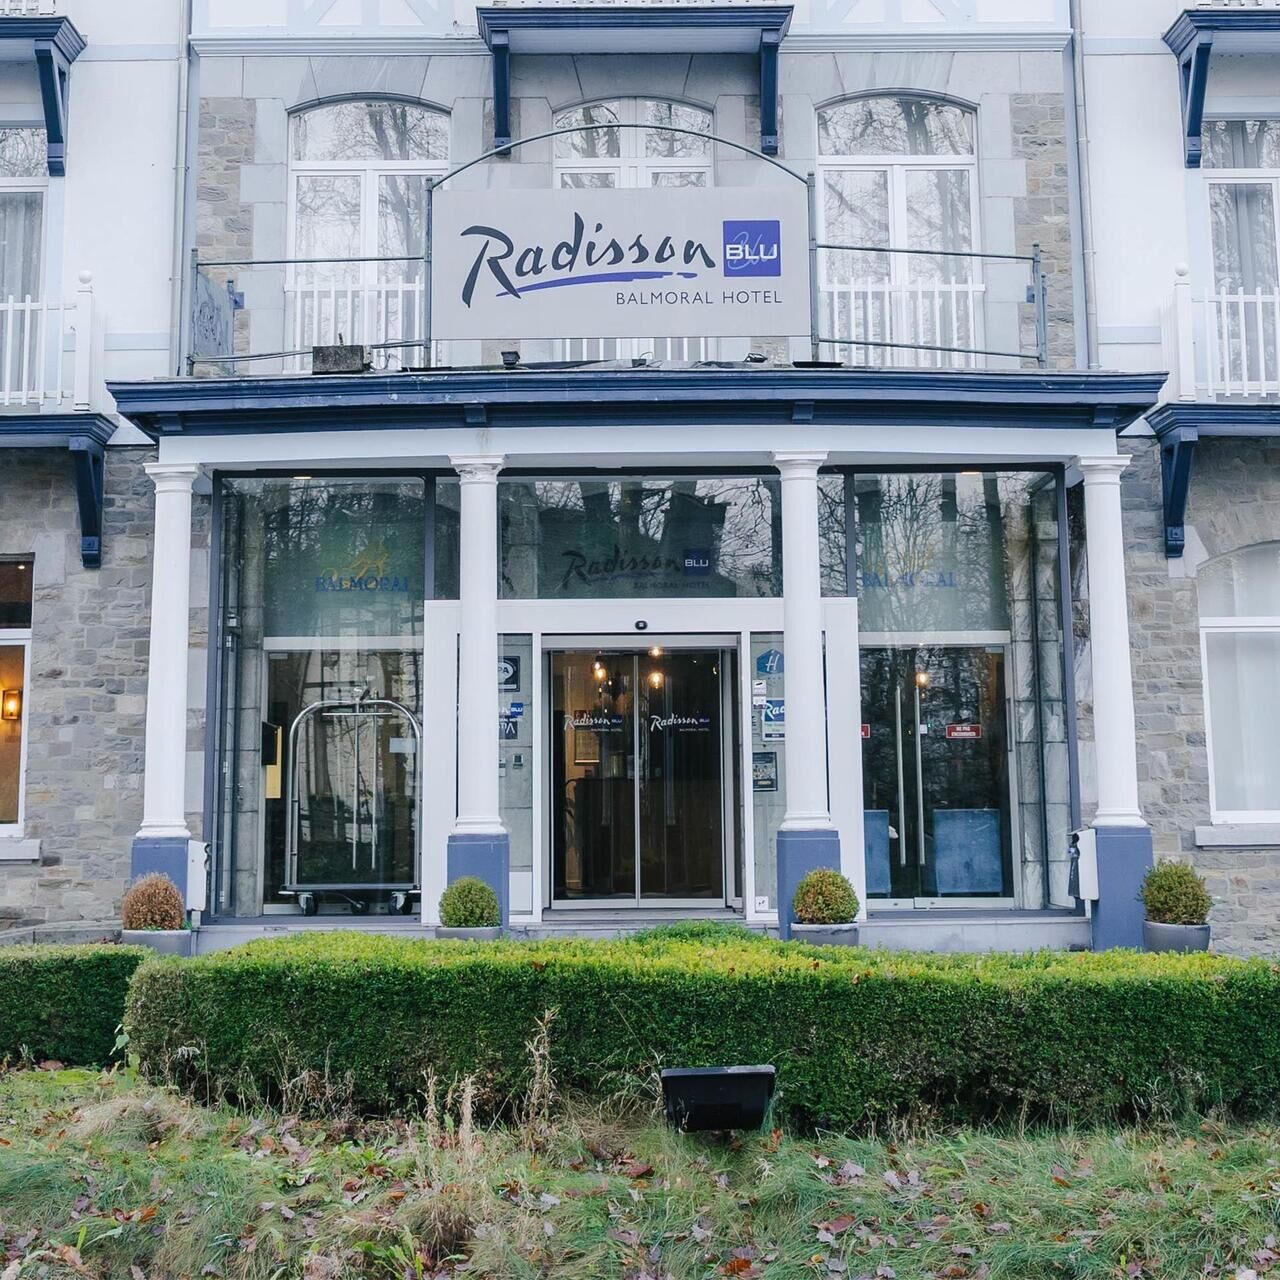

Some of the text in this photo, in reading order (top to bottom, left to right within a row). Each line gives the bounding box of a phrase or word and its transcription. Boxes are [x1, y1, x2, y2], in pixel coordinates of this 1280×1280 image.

[461, 211, 778, 309] Radisson BLU
[616, 290, 783, 305] BALMORAL HOTEL
[562, 544, 709, 590] Radisson BLU
[563, 713, 611, 731] Radisson
[650, 713, 699, 732] Radisson
